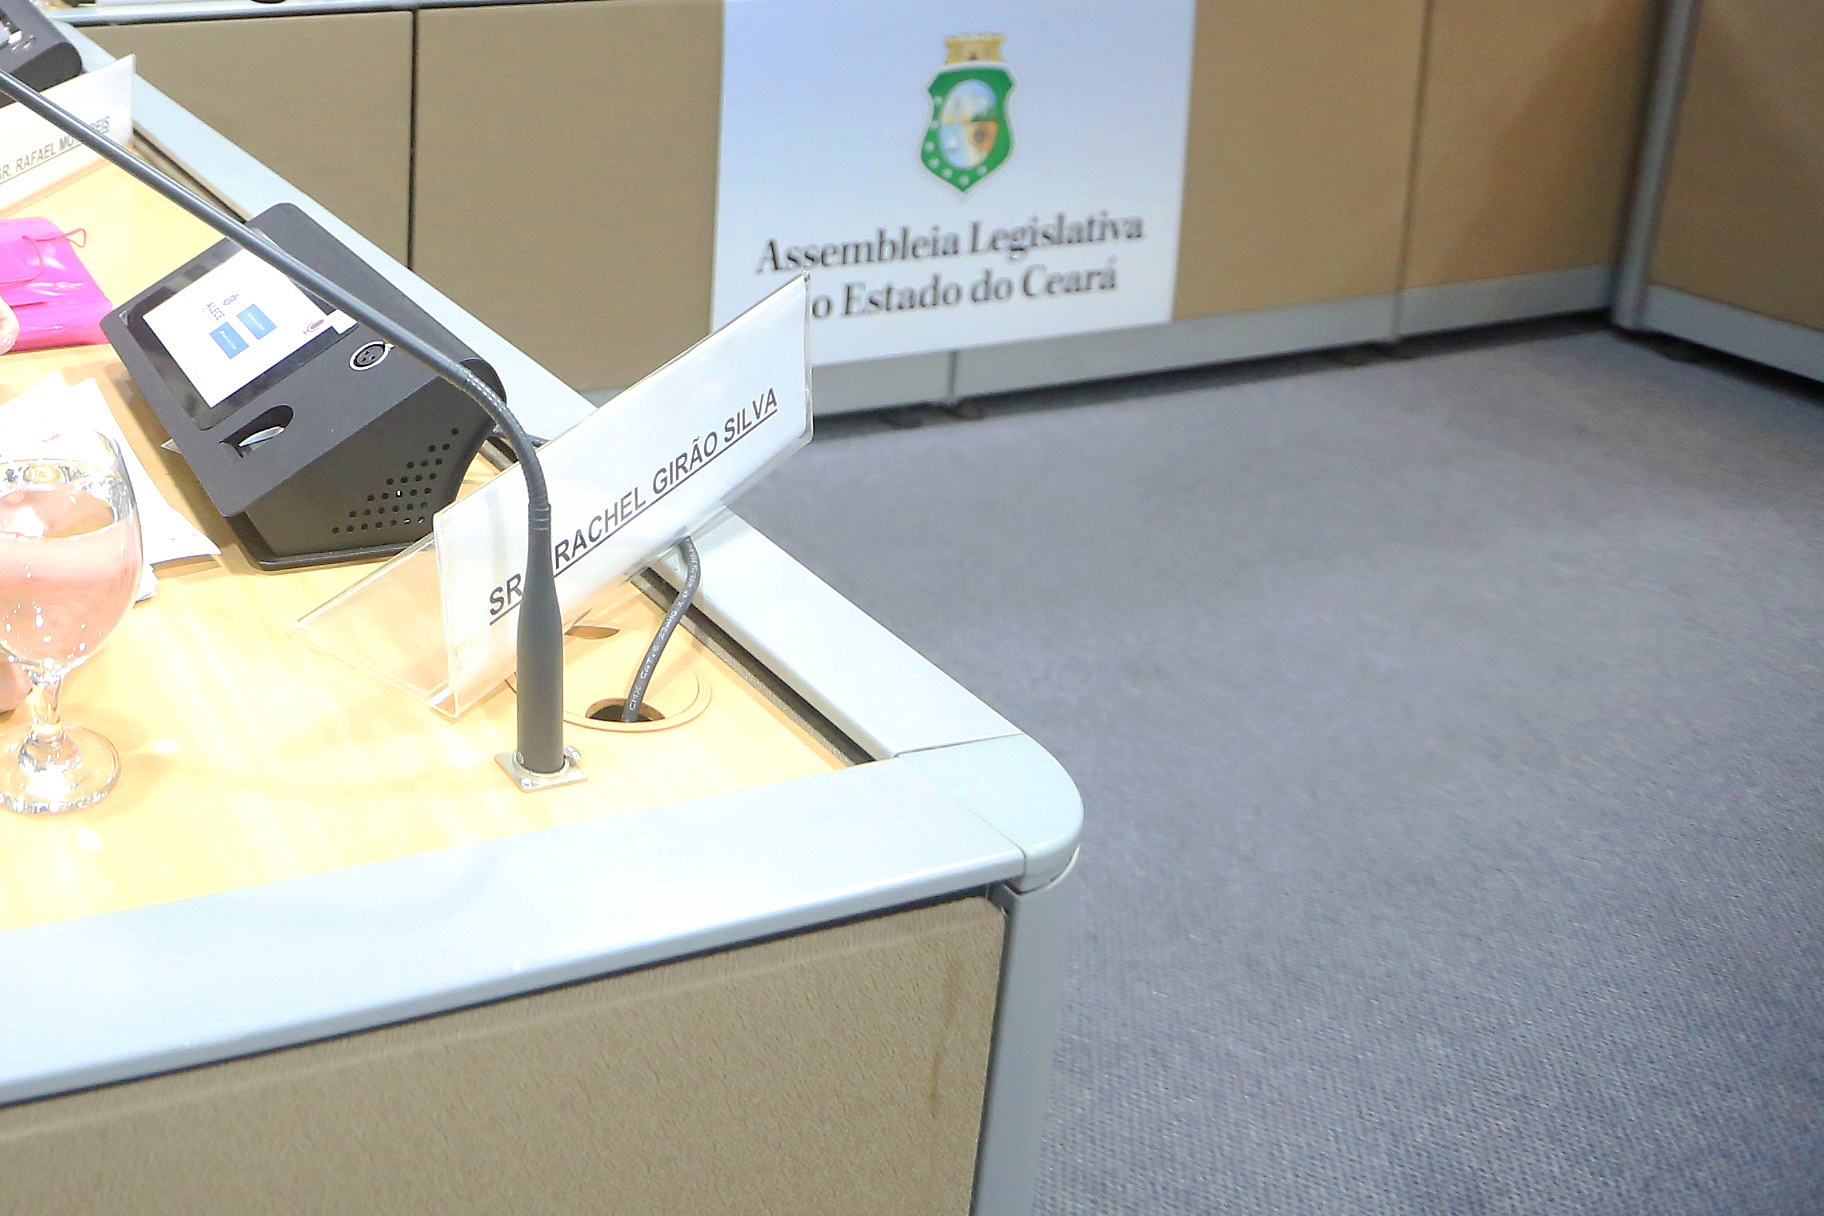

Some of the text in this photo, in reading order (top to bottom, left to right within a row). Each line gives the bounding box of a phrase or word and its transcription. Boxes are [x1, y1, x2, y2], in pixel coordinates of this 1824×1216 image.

[16, 143, 56, 172] RAFAEL
[755, 210, 1144, 274] Assembleia Legislativa
[842, 273, 964, 316] Estado
[970, 268, 1014, 302] do
[1022, 255, 1118, 297] Ceará
[205, 301, 226, 321] ALECE
[554, 487, 647, 570] RACHEL
[653, 431, 718, 494] GIRÃO
[724, 388, 778, 443] SILVA
[629, 685, 642, 711] CMX
